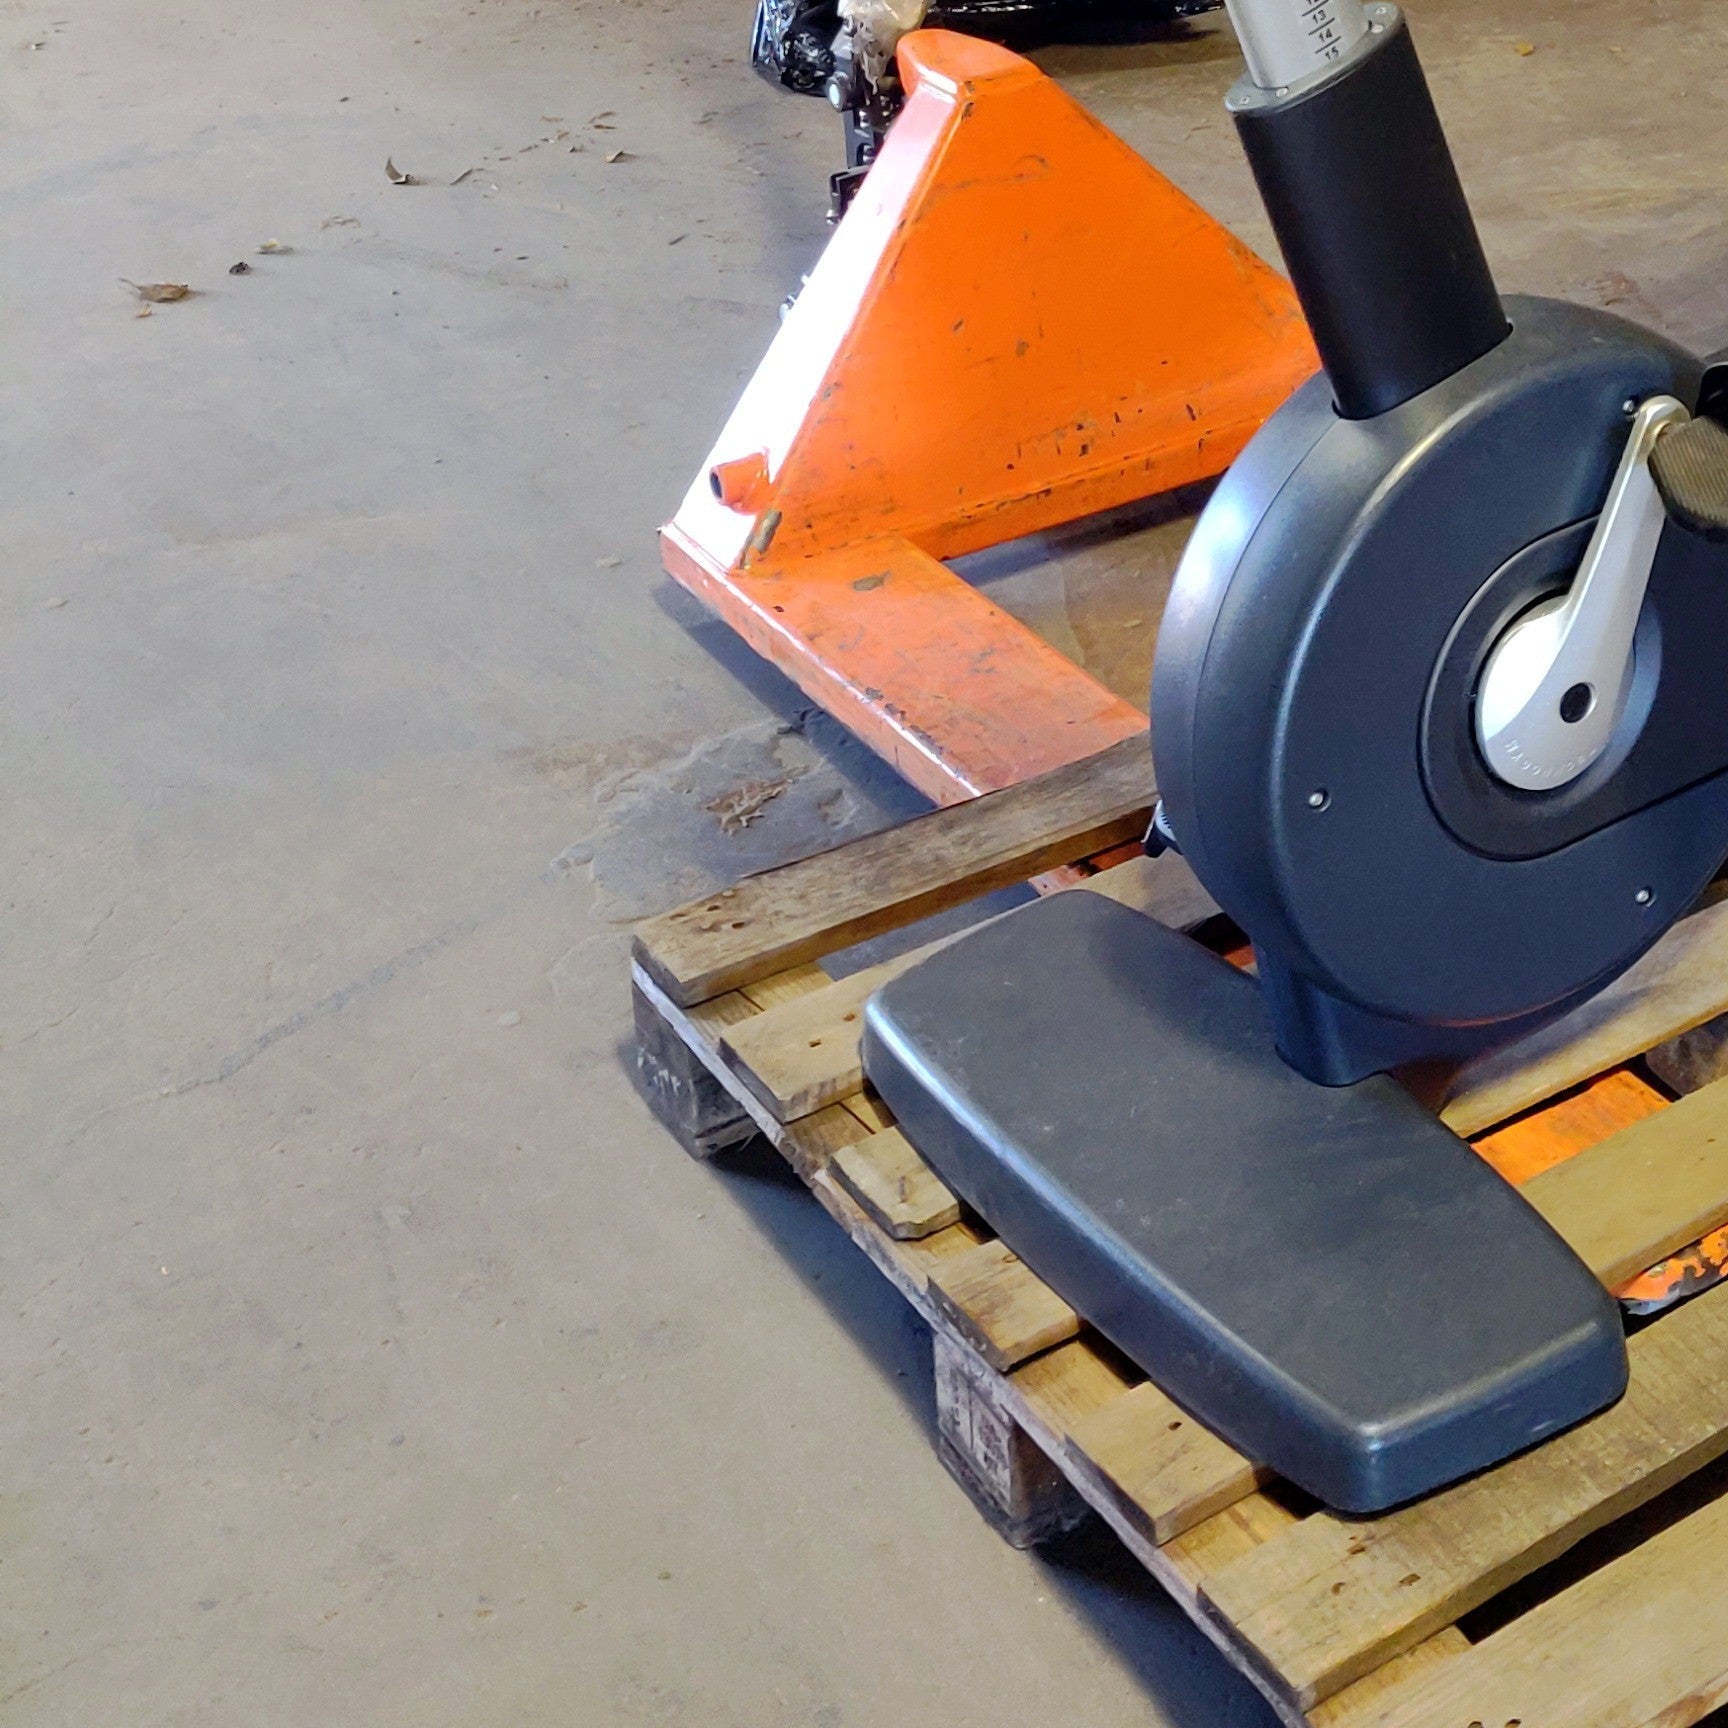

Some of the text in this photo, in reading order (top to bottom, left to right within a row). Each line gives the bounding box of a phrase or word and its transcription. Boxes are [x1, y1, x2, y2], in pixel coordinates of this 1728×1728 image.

[1313, 10, 1327, 24] 13
[1319, 28, 1332, 43] 14
[1325, 46, 1340, 61] 15
